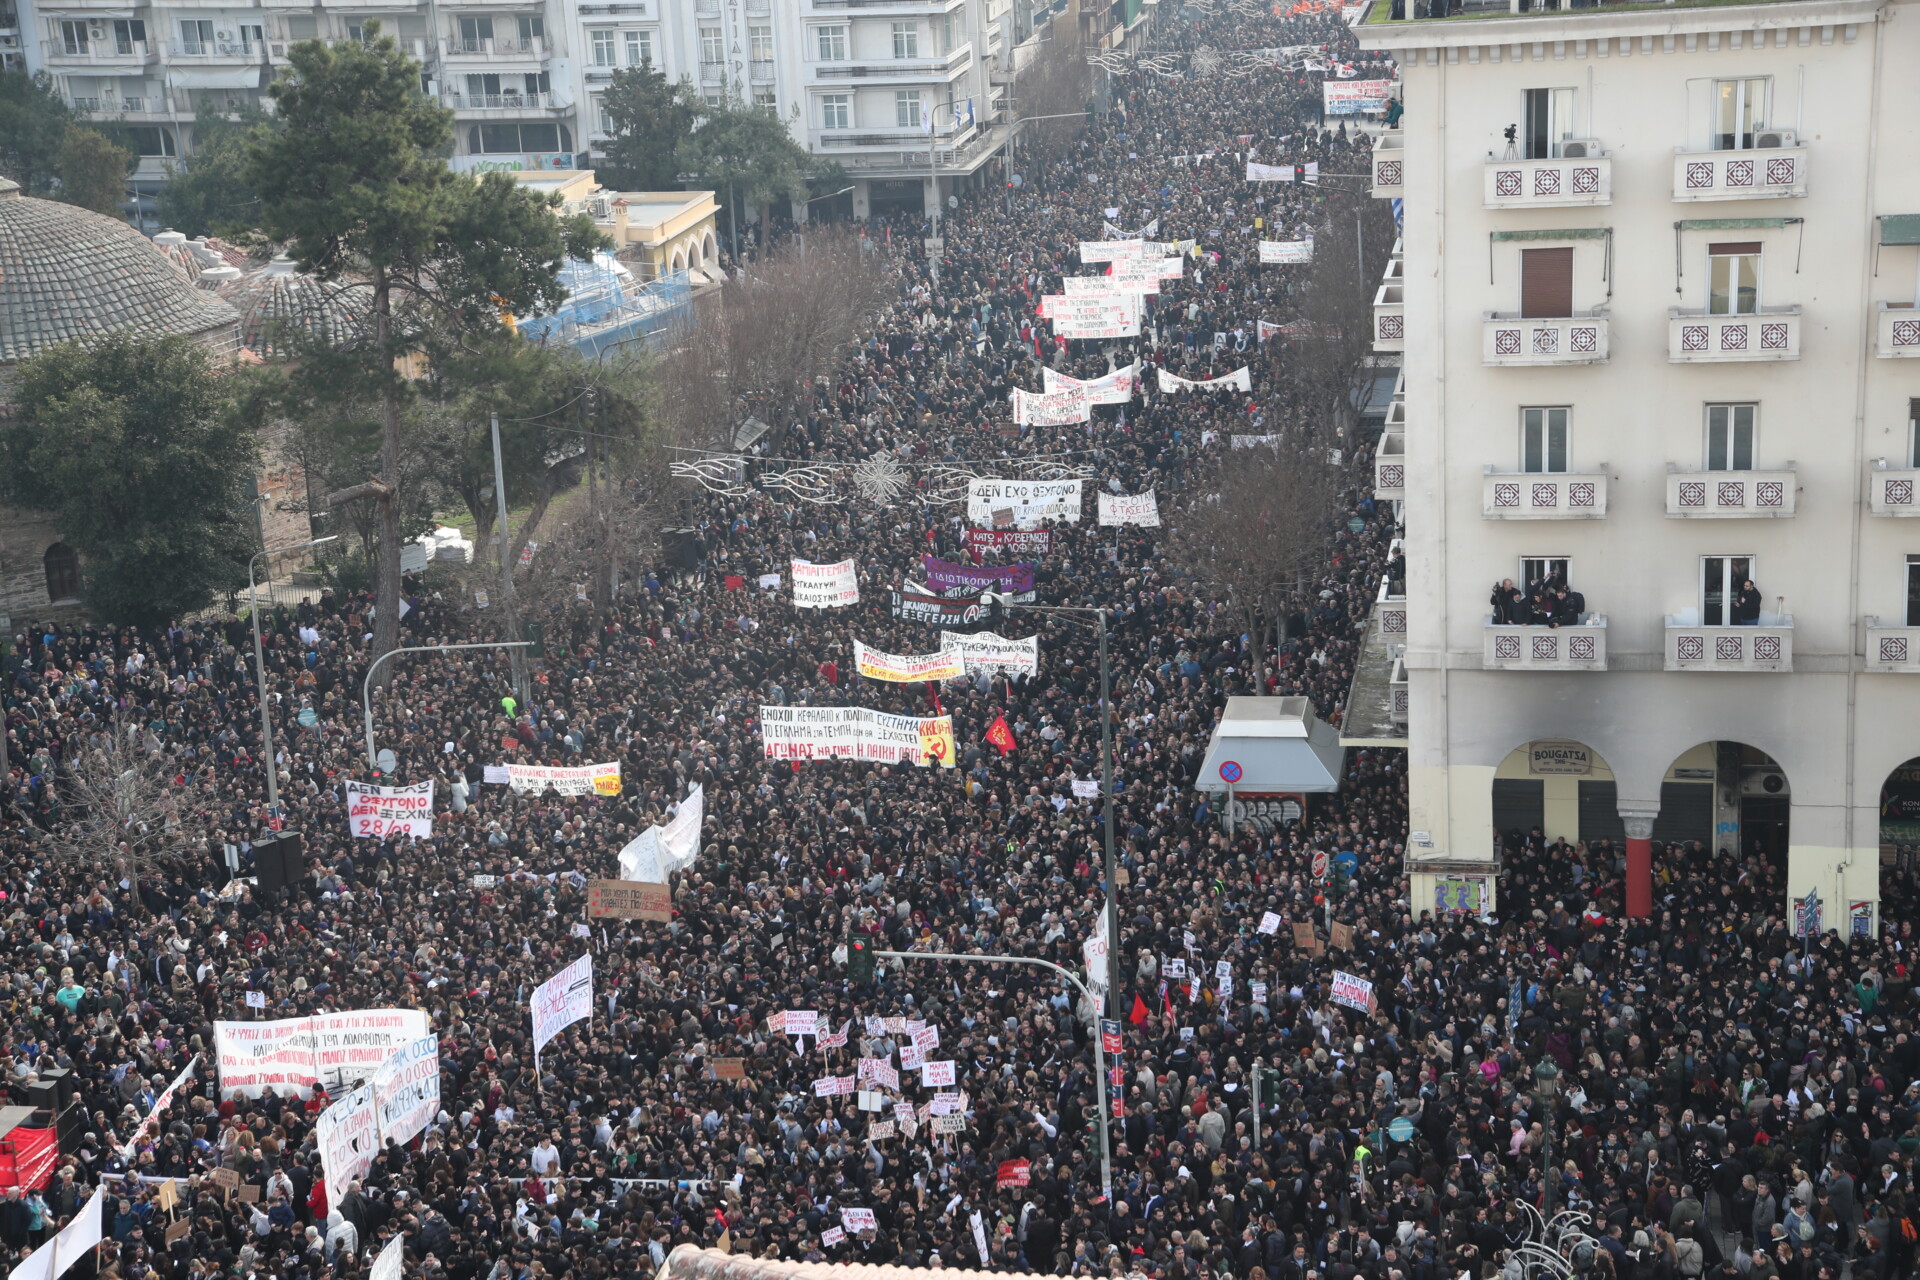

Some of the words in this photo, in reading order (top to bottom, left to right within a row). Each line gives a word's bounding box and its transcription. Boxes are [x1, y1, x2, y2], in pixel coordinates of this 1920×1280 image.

[1110, 503, 1151, 515] ΦΤΑΣΕΙΣ
[1004, 532, 1049, 543] ΚΥΒΕΡΝΗΣΗ
[902, 600, 941, 613] ΔΙΚΑΙΟΣΥΝΗ
[902, 610, 960, 624] ΕΞΕΓΕΡΣΗ
[761, 709, 793, 722] ΕΝΟΧΟΙ
[798, 709, 834, 724] ΚΕΦΑΛΑΙΟ
[877, 714, 919, 732] ΣΥΣΤΗΜΑ
[764, 725, 773, 737] ΤΟ
[774, 724, 812, 738] ΕΓΚΛΗΜΑ
[824, 724, 850, 737] ΤΕΜΠΗ
[877, 727, 918, 744] ΞΕΧΑΣΤΕΙ
[766, 743, 814, 758] ΑΓΩΝΑΣ
[817, 745, 831, 756] ΝΑ
[833, 744, 854, 756] ΓΙΝΕΙ
[857, 743, 864, 757] Η
[1535, 750, 1586, 761] BOUGATSA
[528, 778, 539, 786] ΜΗ
[348, 783, 380, 795] ΔΕΝ
[360, 795, 427, 809] ΟΞΥΓΟΝΟ
[351, 805, 378, 816] ΔΕΝ
[380, 808, 432, 820] ΞΕΧΝΩ
[1313, 858, 1326, 874] STOP
[225, 1028, 235, 1039] 57
[323, 1035, 338, 1046] ΤΩΝ
[342, 1033, 391, 1046] ΔΟΛΟΦΟΝΩΝ
[823, 1229, 839, 1238] ΗΤΑΝ
